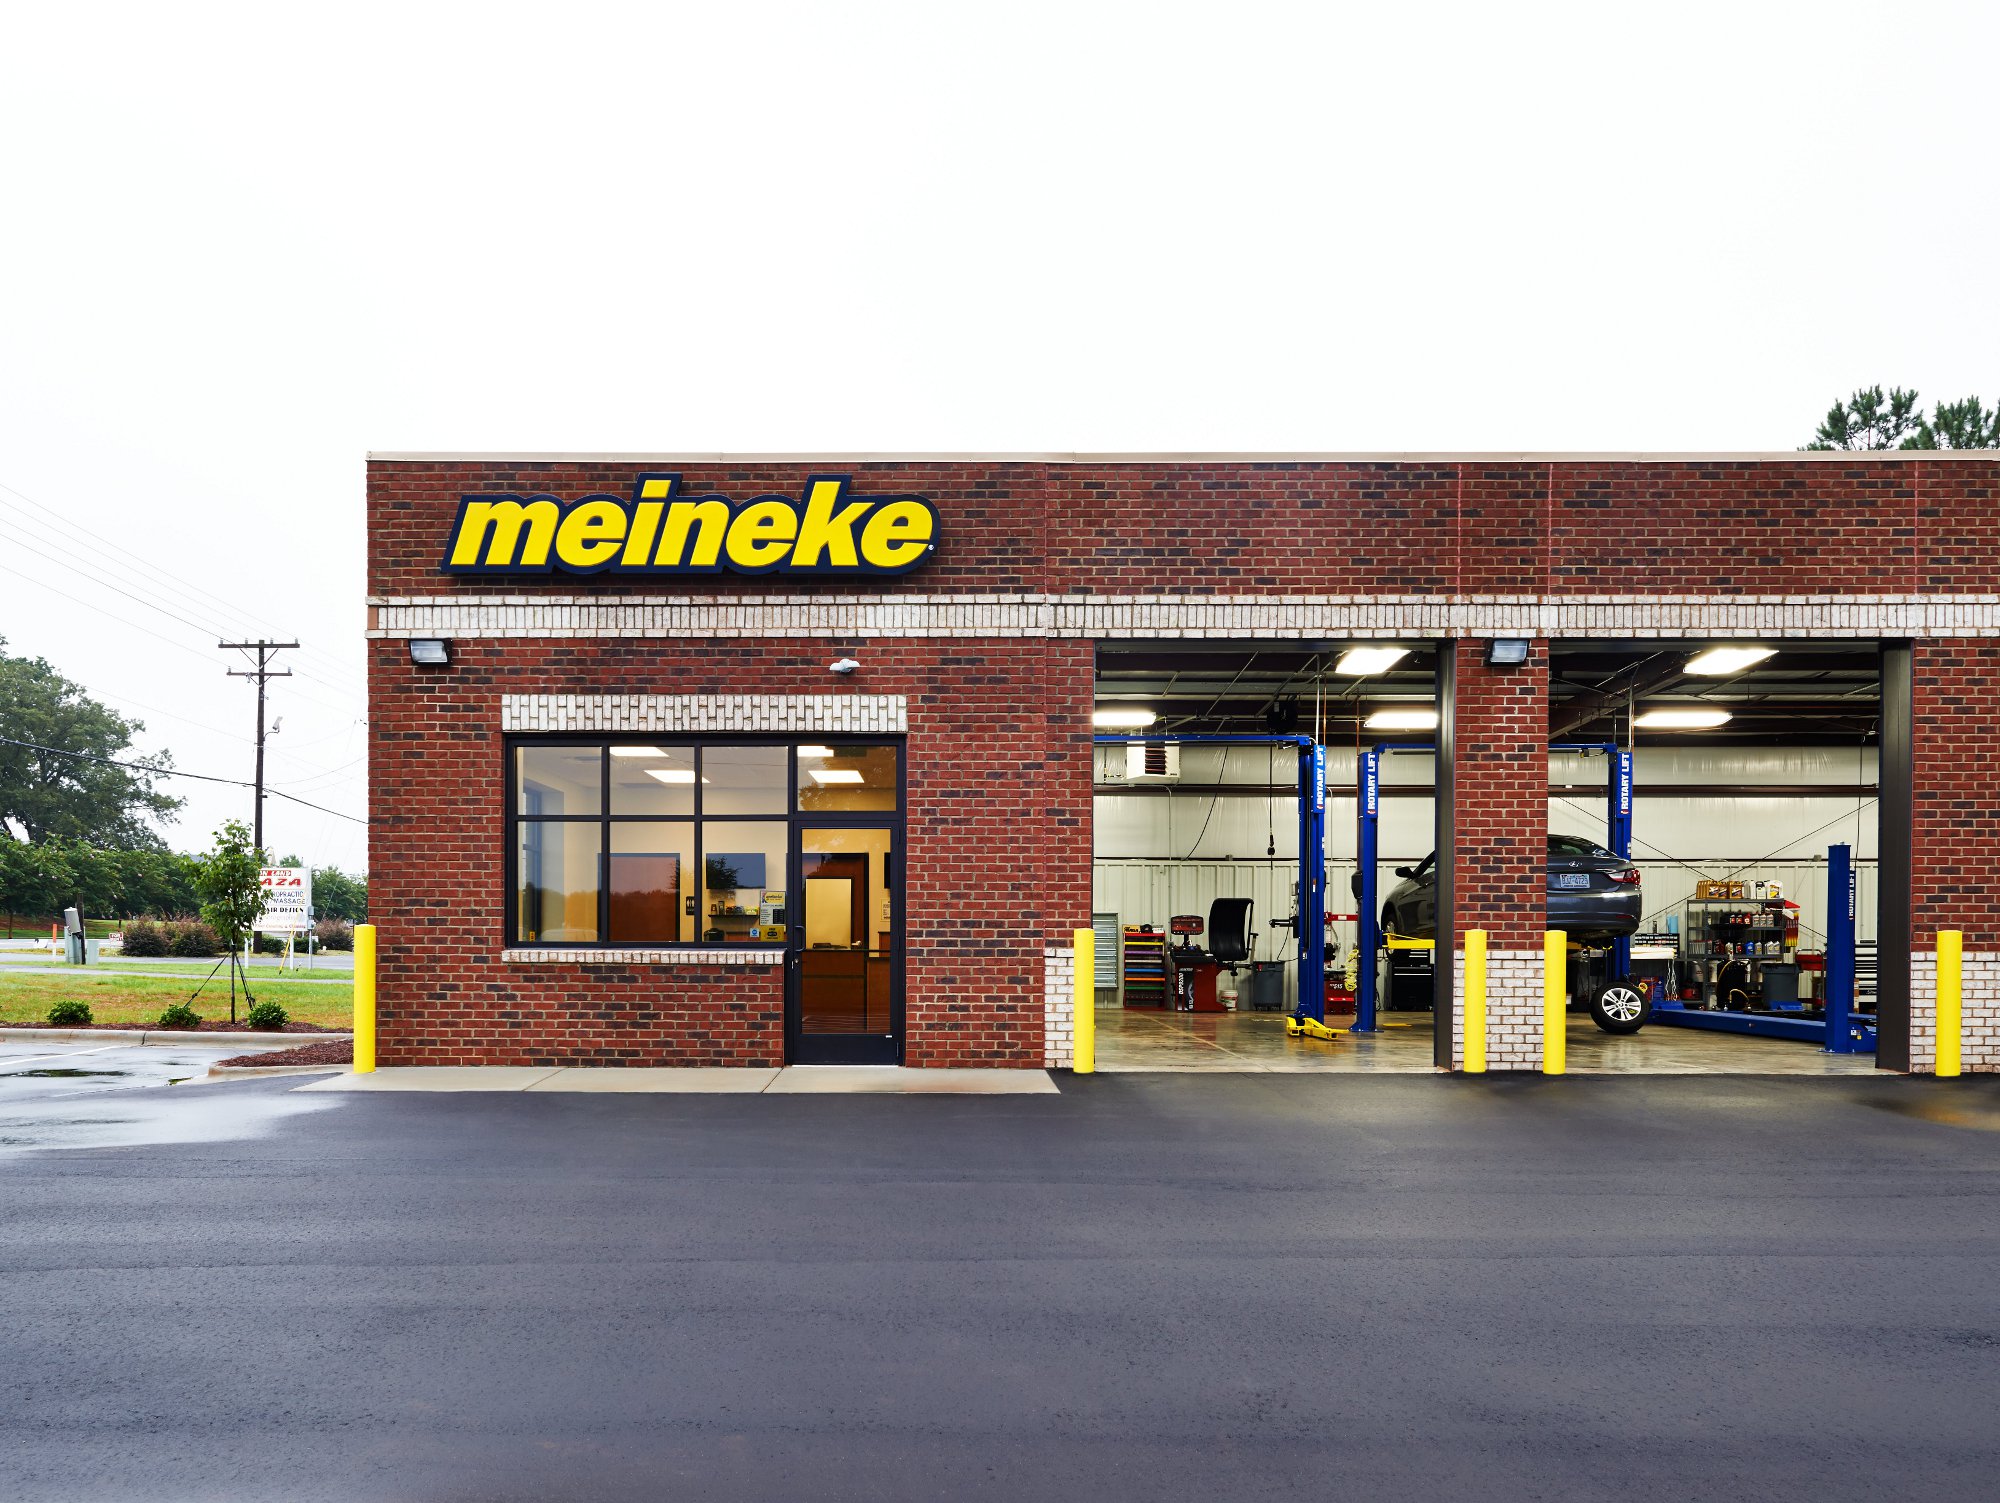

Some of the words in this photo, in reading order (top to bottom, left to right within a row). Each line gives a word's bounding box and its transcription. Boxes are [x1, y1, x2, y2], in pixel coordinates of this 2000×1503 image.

[449, 479, 934, 567] meineke
[1316, 745, 1324, 766] LIFT
[1367, 753, 1376, 772] LIFT
[1622, 753, 1630, 772] LIFT
[1316, 768, 1324, 805] ROTARY
[1367, 774, 1376, 810] ROTARY
[1621, 774, 1629, 810] ROTARY
[260, 878, 301, 886] AZA
